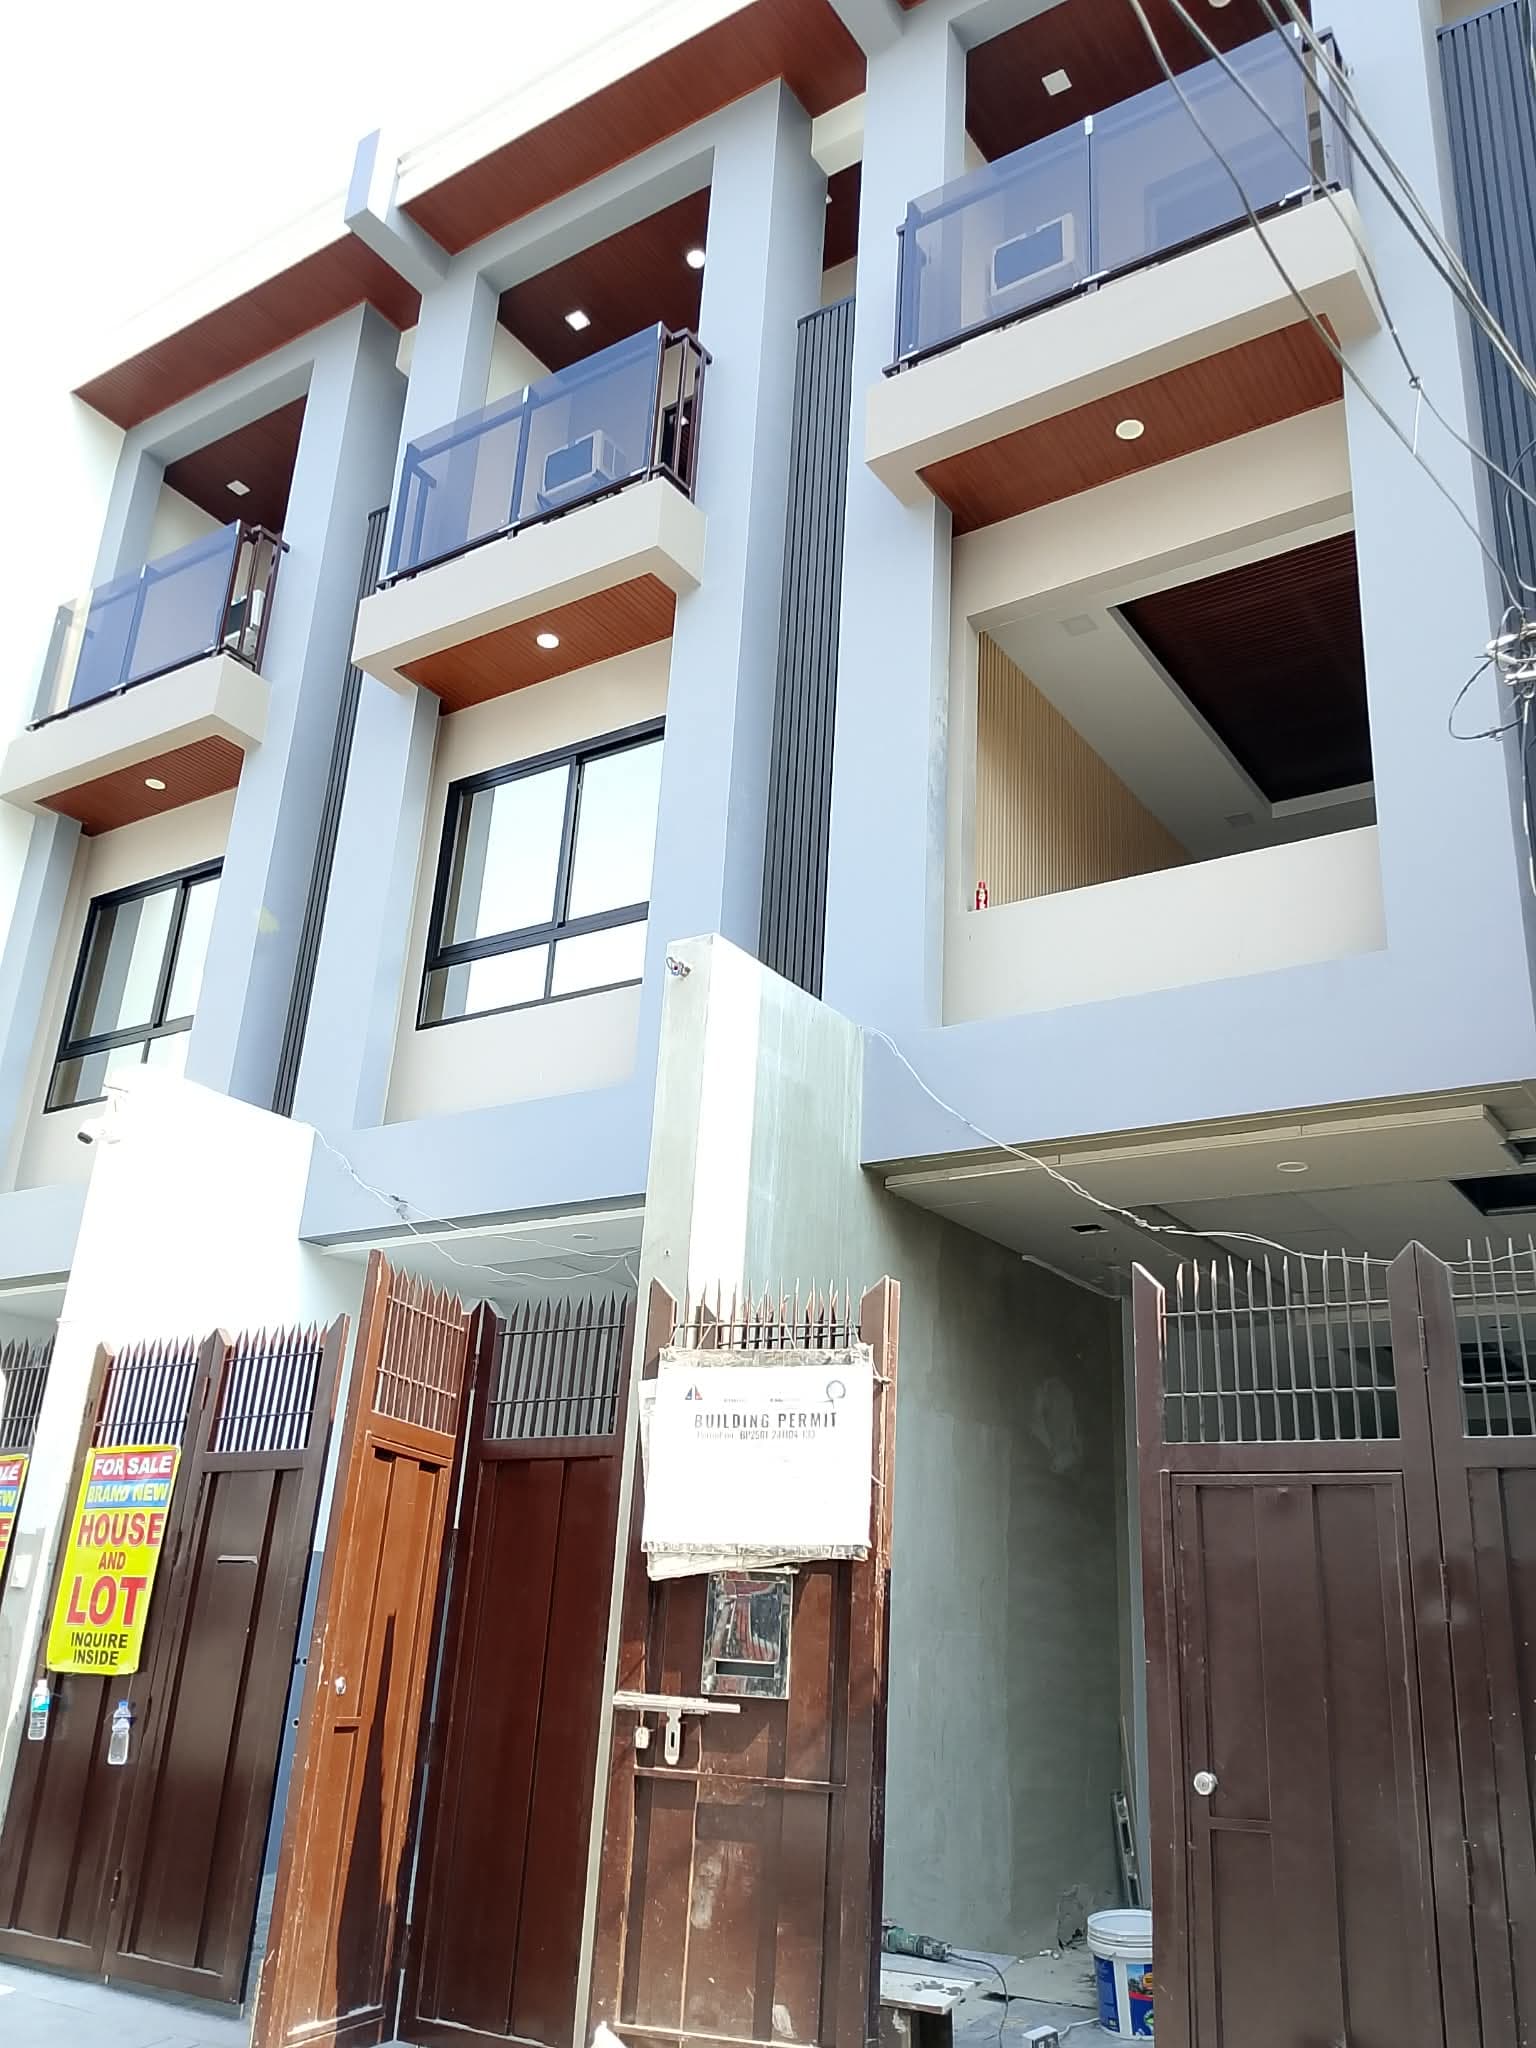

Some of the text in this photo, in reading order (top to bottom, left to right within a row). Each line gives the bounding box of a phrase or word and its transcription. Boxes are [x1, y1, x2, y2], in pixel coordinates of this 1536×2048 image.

[694, 1412, 838, 1429] BUILDING PERMIT
[93, 1455, 173, 1476] FOR SALE
[87, 1482, 170, 1503] BRAND NEW
[77, 1512, 165, 1548] HOUSE
[98, 1551, 127, 1570] AND
[65, 1575, 148, 1628] LOT
[70, 1632, 129, 1649] INQUIRE
[73, 1649, 119, 1666] INSIDE
